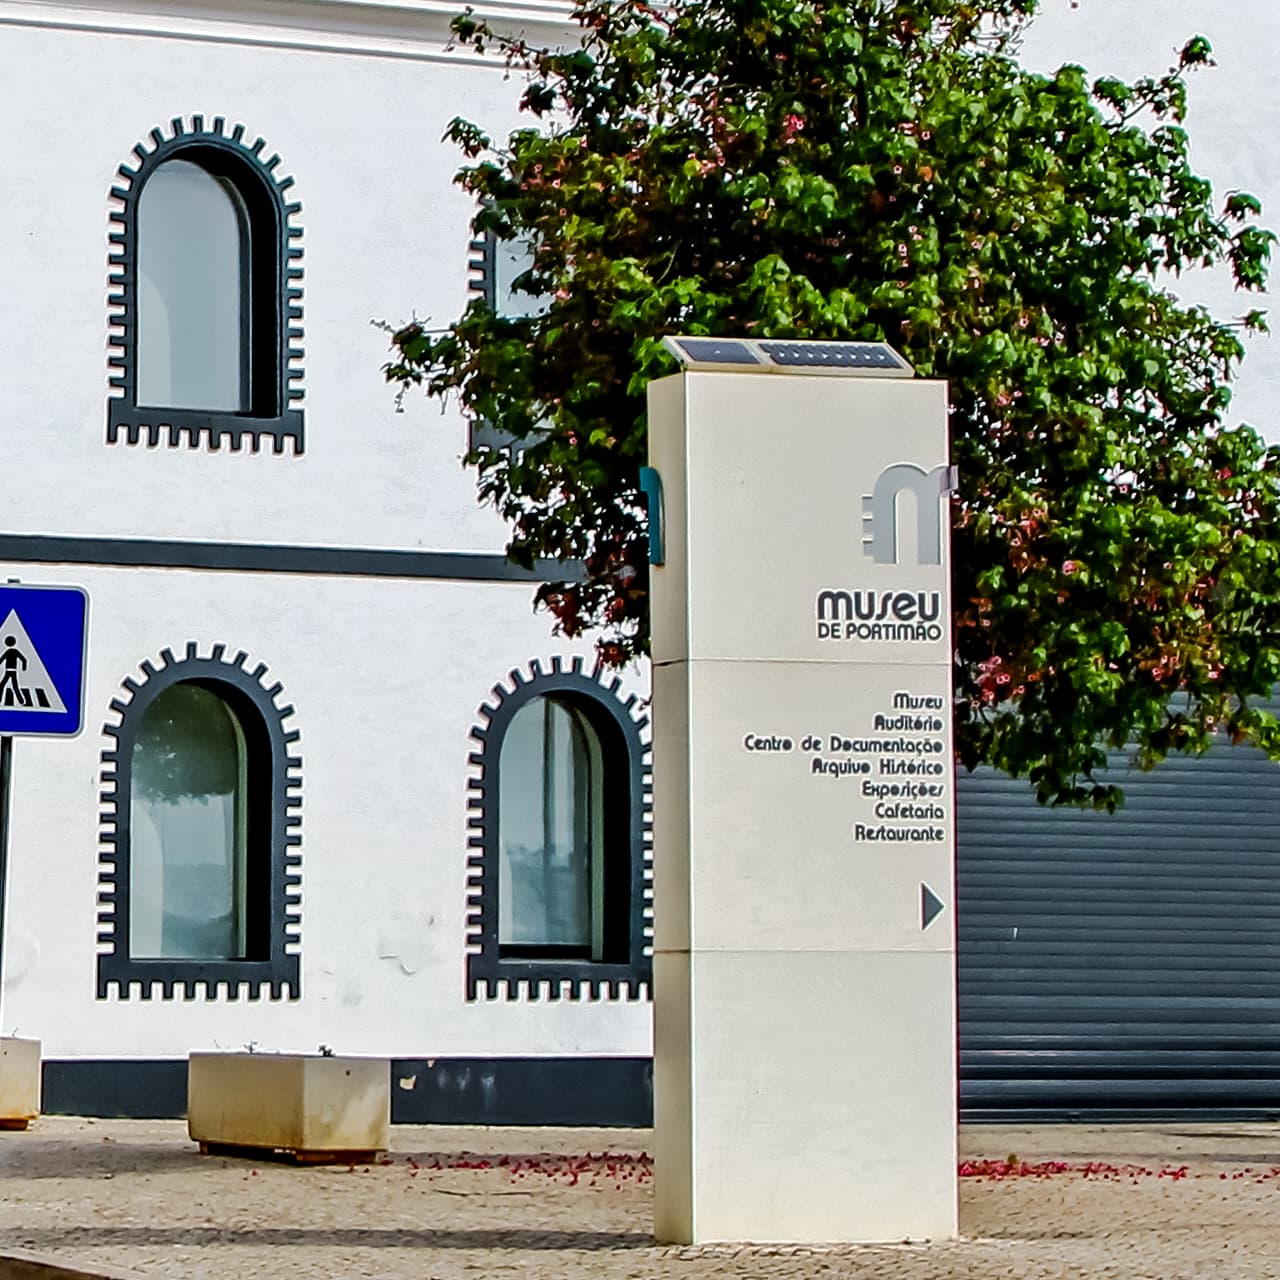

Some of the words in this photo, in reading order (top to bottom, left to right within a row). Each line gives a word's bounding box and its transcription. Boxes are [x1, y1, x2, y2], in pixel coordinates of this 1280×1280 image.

[817, 622, 842, 639] DE
[846, 620, 942, 641] PORTIMÃO
[893, 693, 943, 709] Museu
[874, 714, 943, 731] Auditório
[744, 734, 793, 751] Centro
[801, 735, 822, 751] de
[830, 735, 943, 756] Documentação
[811, 757, 871, 778] Arquivo
[879, 758, 943, 775] Histórico
[862, 780, 944, 800] Exposições
[874, 803, 944, 820] Cafetaria
[854, 824, 945, 842] Restaurante
